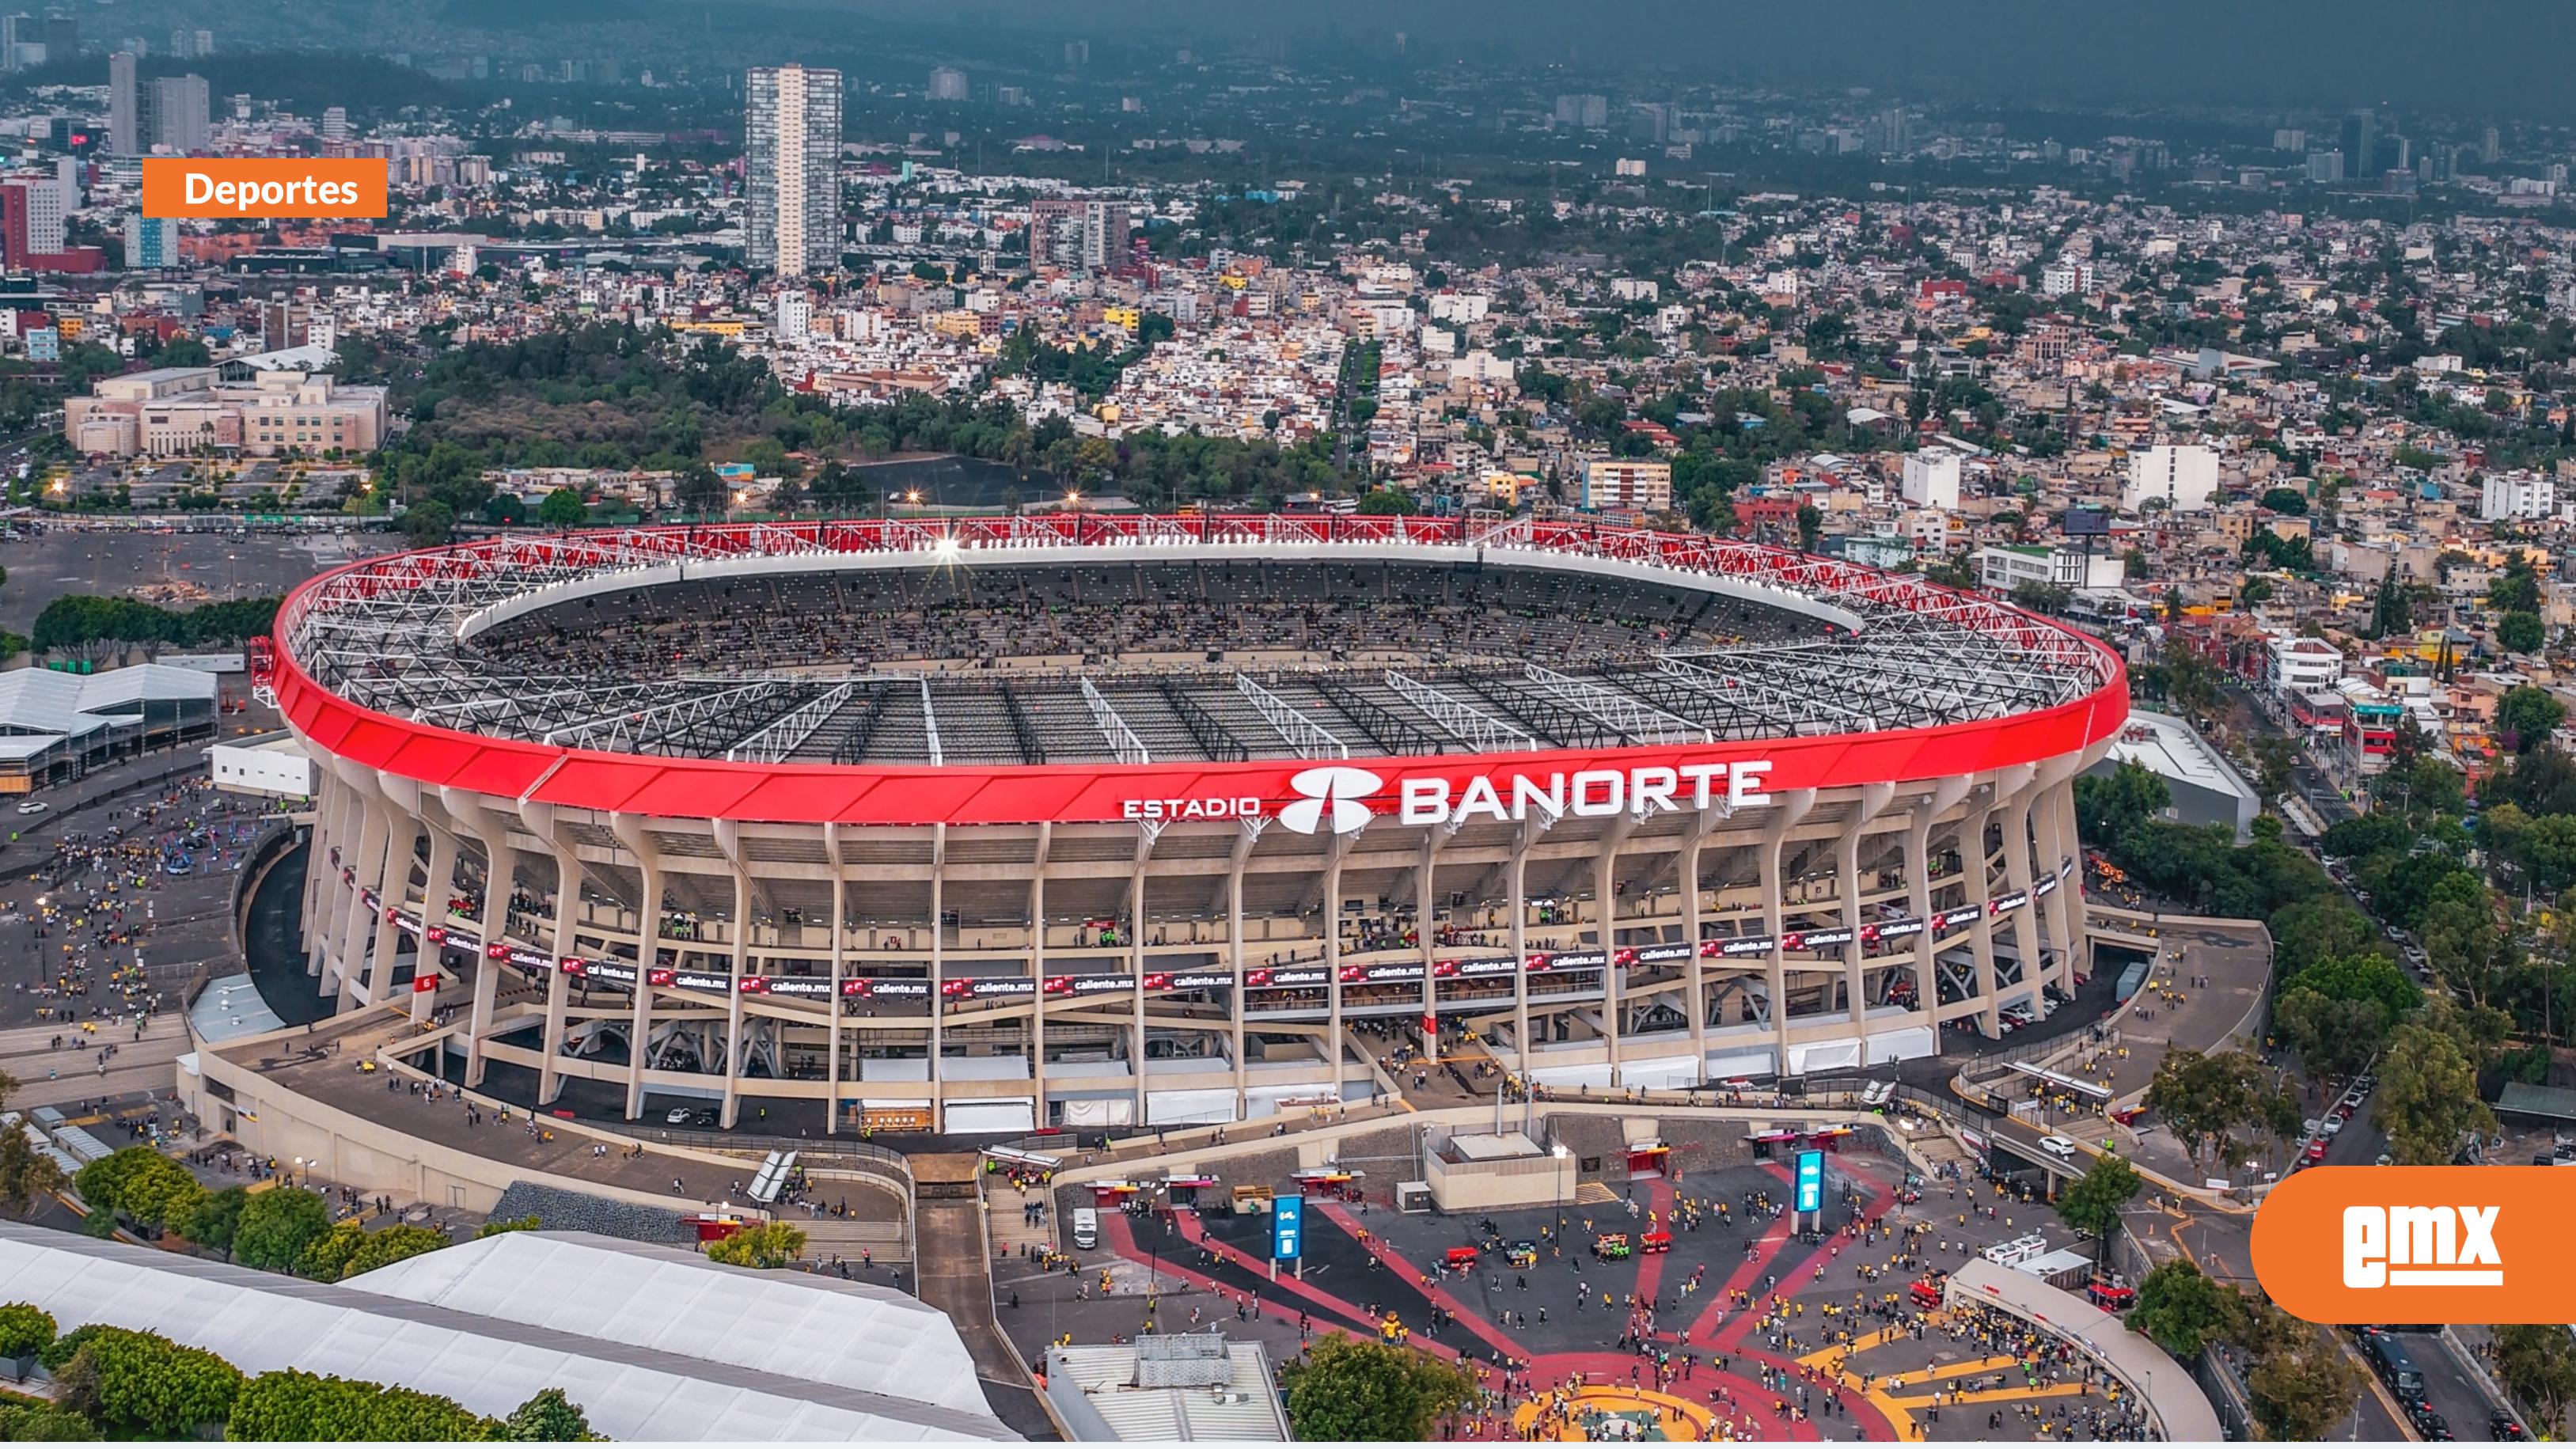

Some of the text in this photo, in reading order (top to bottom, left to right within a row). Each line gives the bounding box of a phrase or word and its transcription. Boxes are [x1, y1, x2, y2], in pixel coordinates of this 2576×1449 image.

[1124, 761, 1772, 825] ESTADIO BANORTE
[1880, 923, 1922, 935] caliente.mx
[1805, 933, 1852, 945] caliente.mx
[1724, 941, 1773, 952] caliente.mx
[1640, 948, 1690, 960] caliente.mx
[1552, 956, 1605, 966] caliente.mx
[1368, 967, 1424, 978] caliente.mx
[1462, 962, 1516, 973] caliente.mx
[423, 978, 431, 988] 6
[677, 977, 727, 989] caliente.mx
[1174, 977, 1232, 987] caliente.mx
[1274, 972, 1326, 983] caliente.mx
[771, 982, 830, 992] caliente.mx
[873, 984, 927, 994] caliente.mx
[973, 983, 1034, 992] caliente.mx
[1075, 980, 1134, 990] caliente.mx
